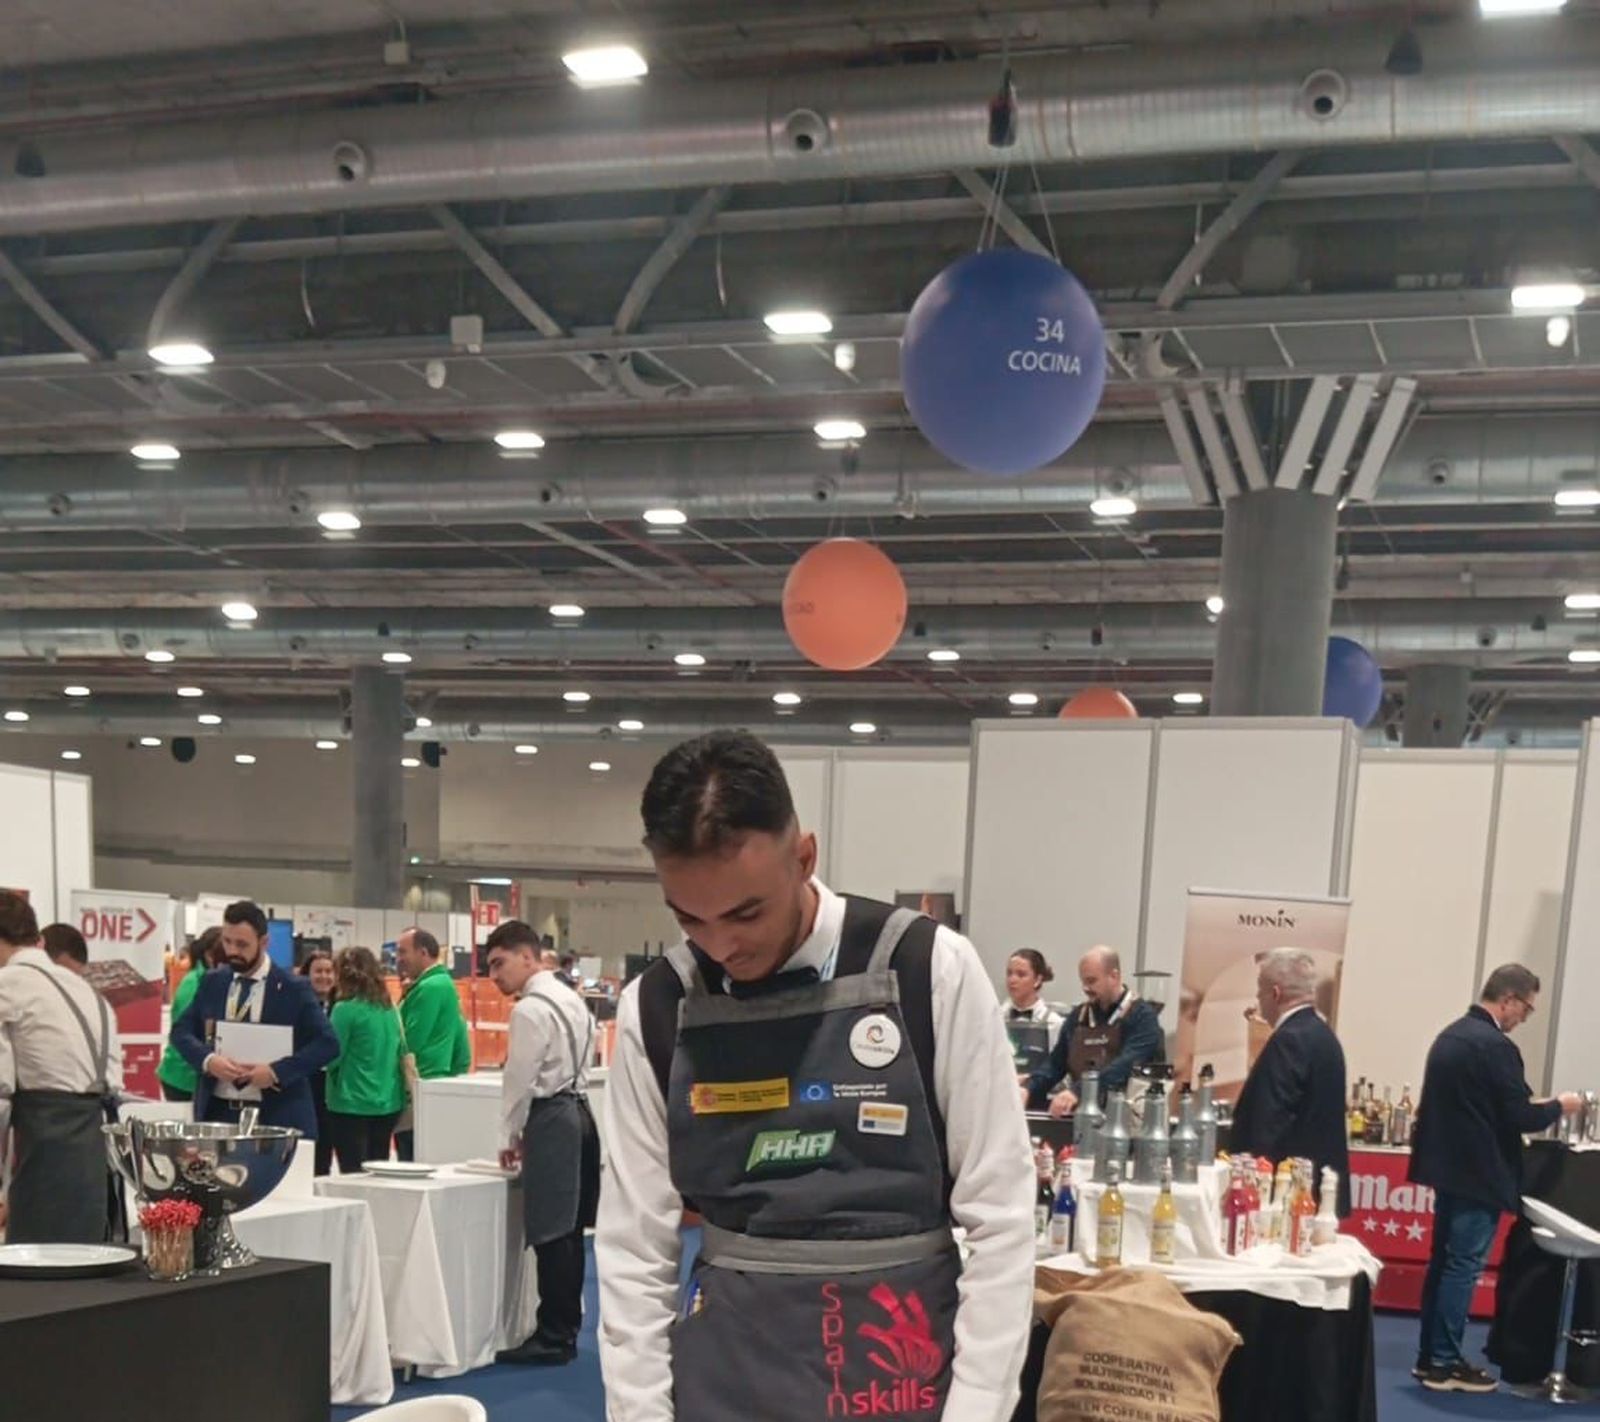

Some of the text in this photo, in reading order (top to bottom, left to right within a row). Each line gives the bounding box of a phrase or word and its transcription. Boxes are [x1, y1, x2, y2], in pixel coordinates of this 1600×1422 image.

[1035, 317, 1065, 343] 34
[1008, 350, 1081, 375] COCINA
[81, 911, 133, 942] ONE
[1083, 1352, 1171, 1377] COOPERATIVA
[853, 1379, 937, 1416] skills
[1103, 1403, 1152, 1422] COFFEE
